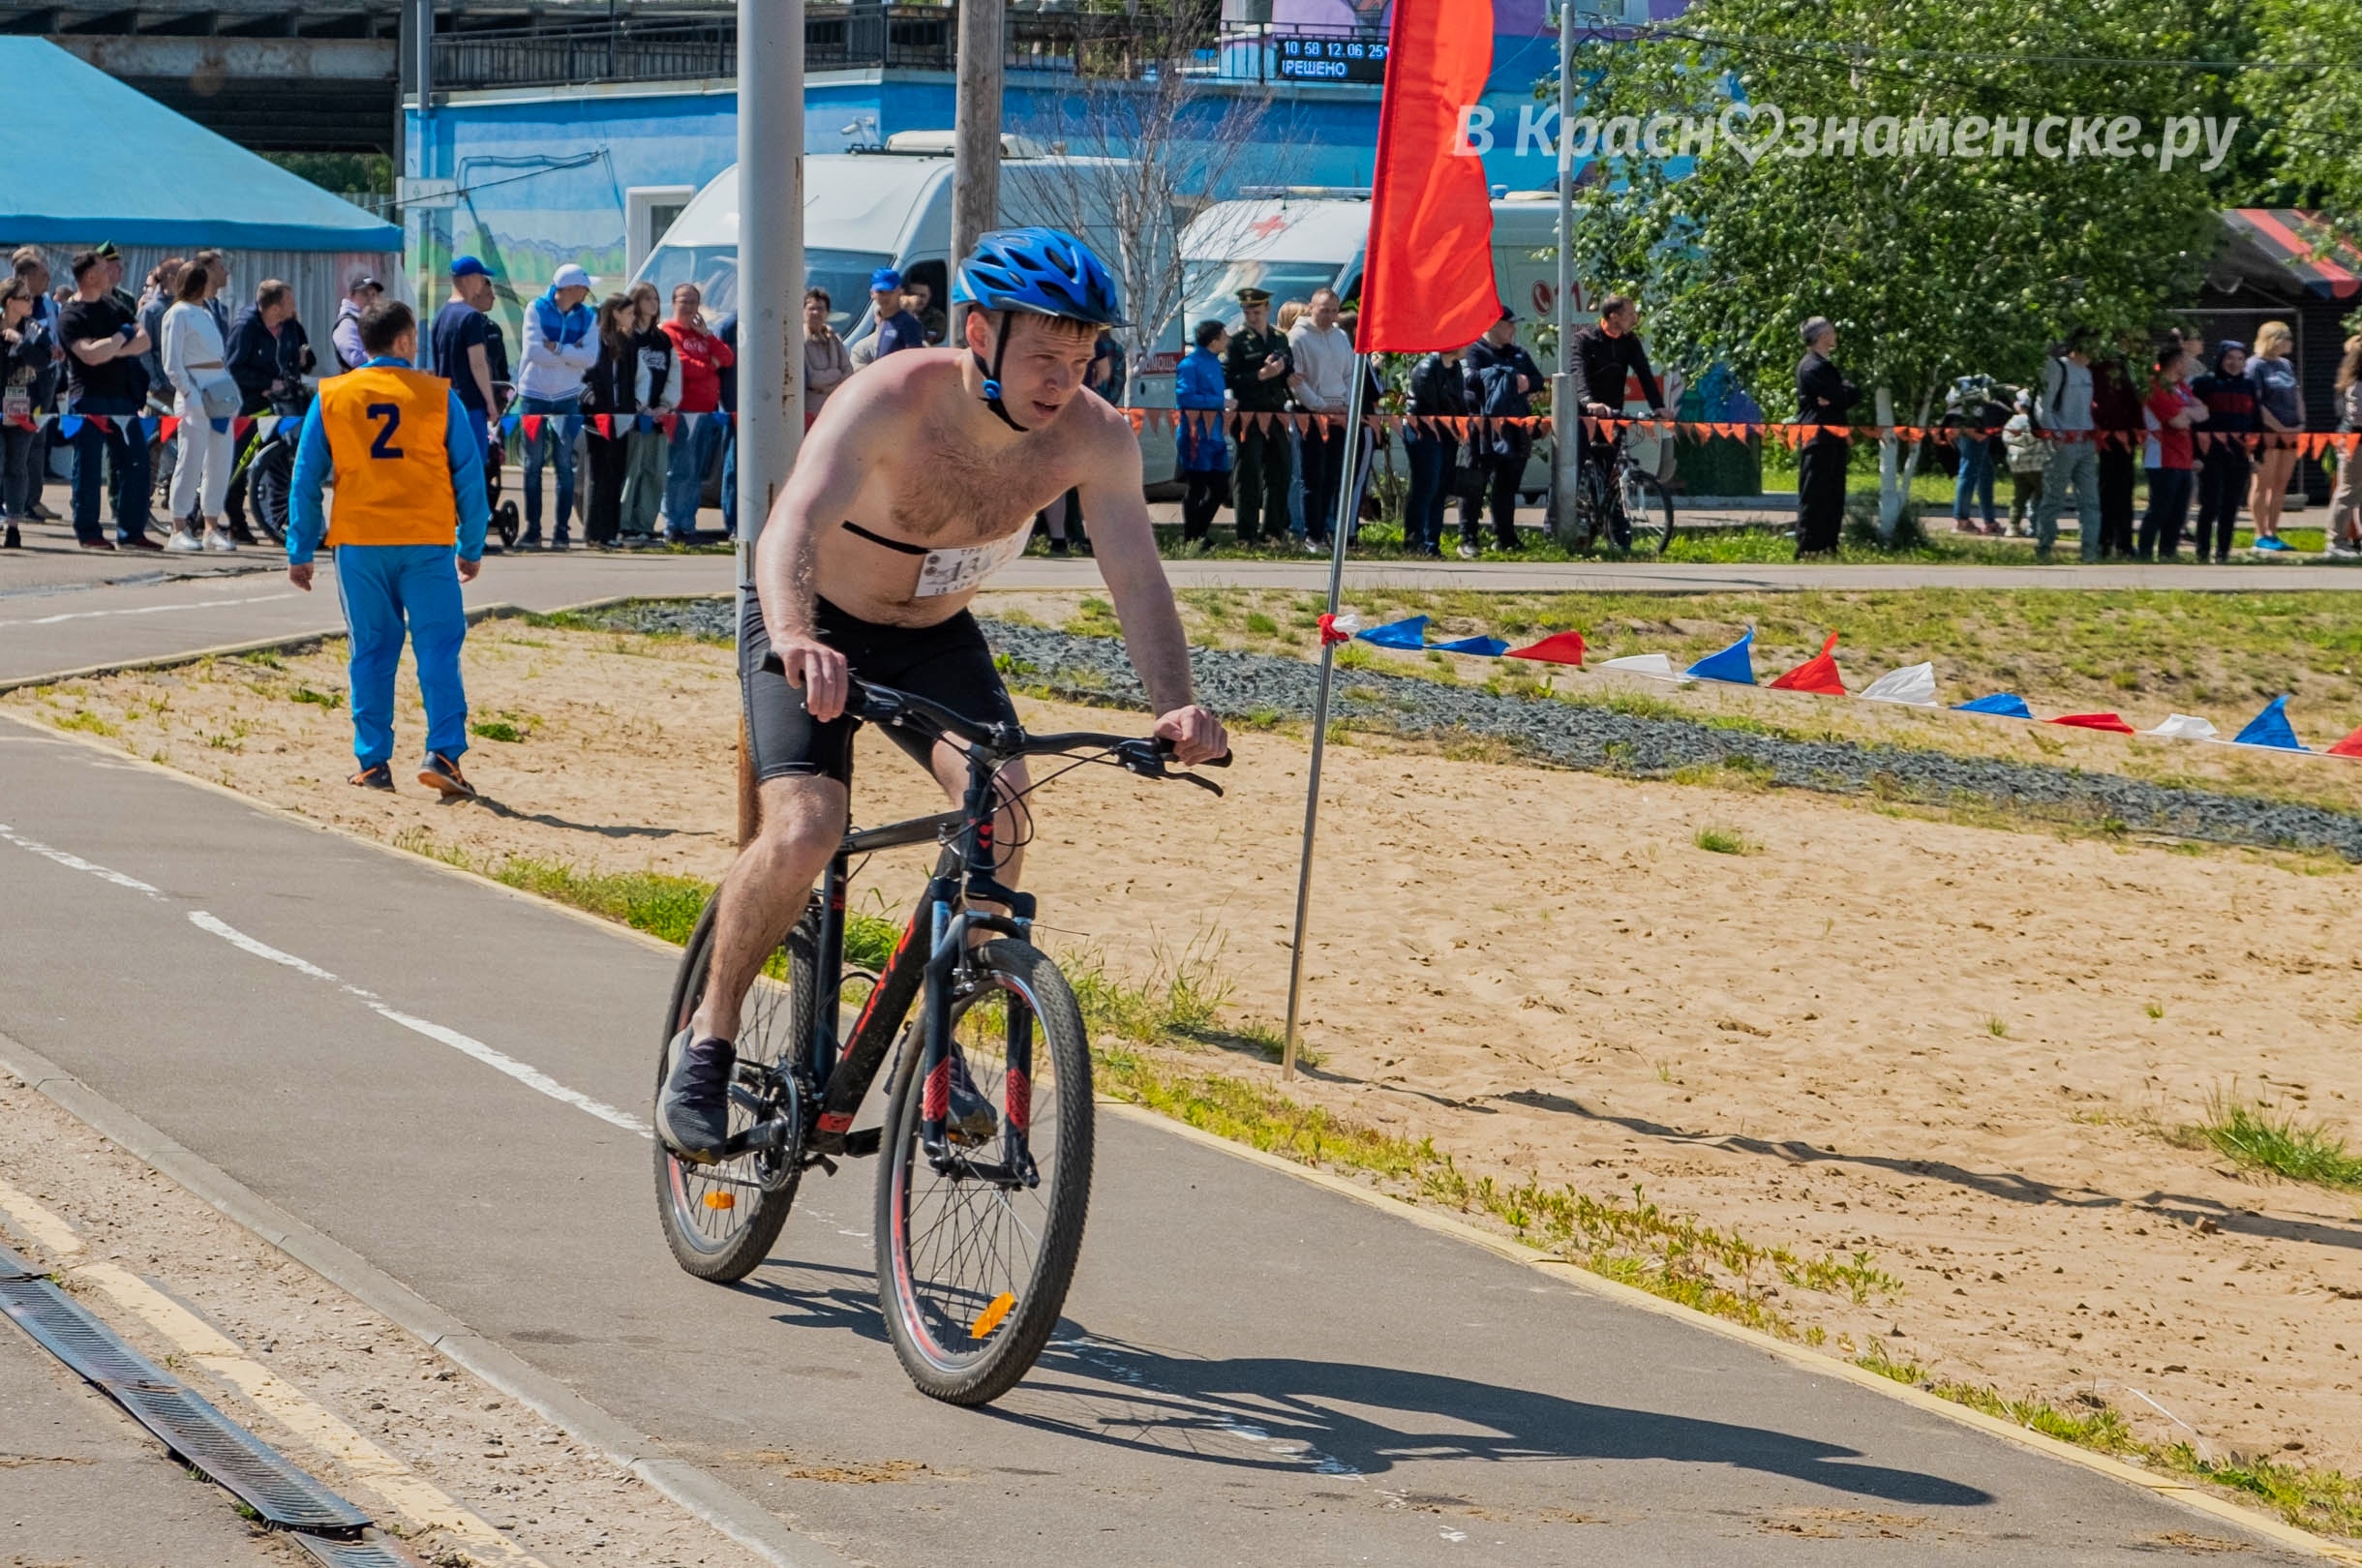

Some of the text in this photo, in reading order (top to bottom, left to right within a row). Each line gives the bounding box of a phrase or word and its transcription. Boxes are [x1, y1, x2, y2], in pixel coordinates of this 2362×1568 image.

[1284, 41, 1299, 56] 10
[1304, 42, 1320, 56] 58
[1327, 43, 1364, 58] 12.06
[1139, 355, 1177, 373] ОМОЩЬ
[367, 403, 405, 460] 2
